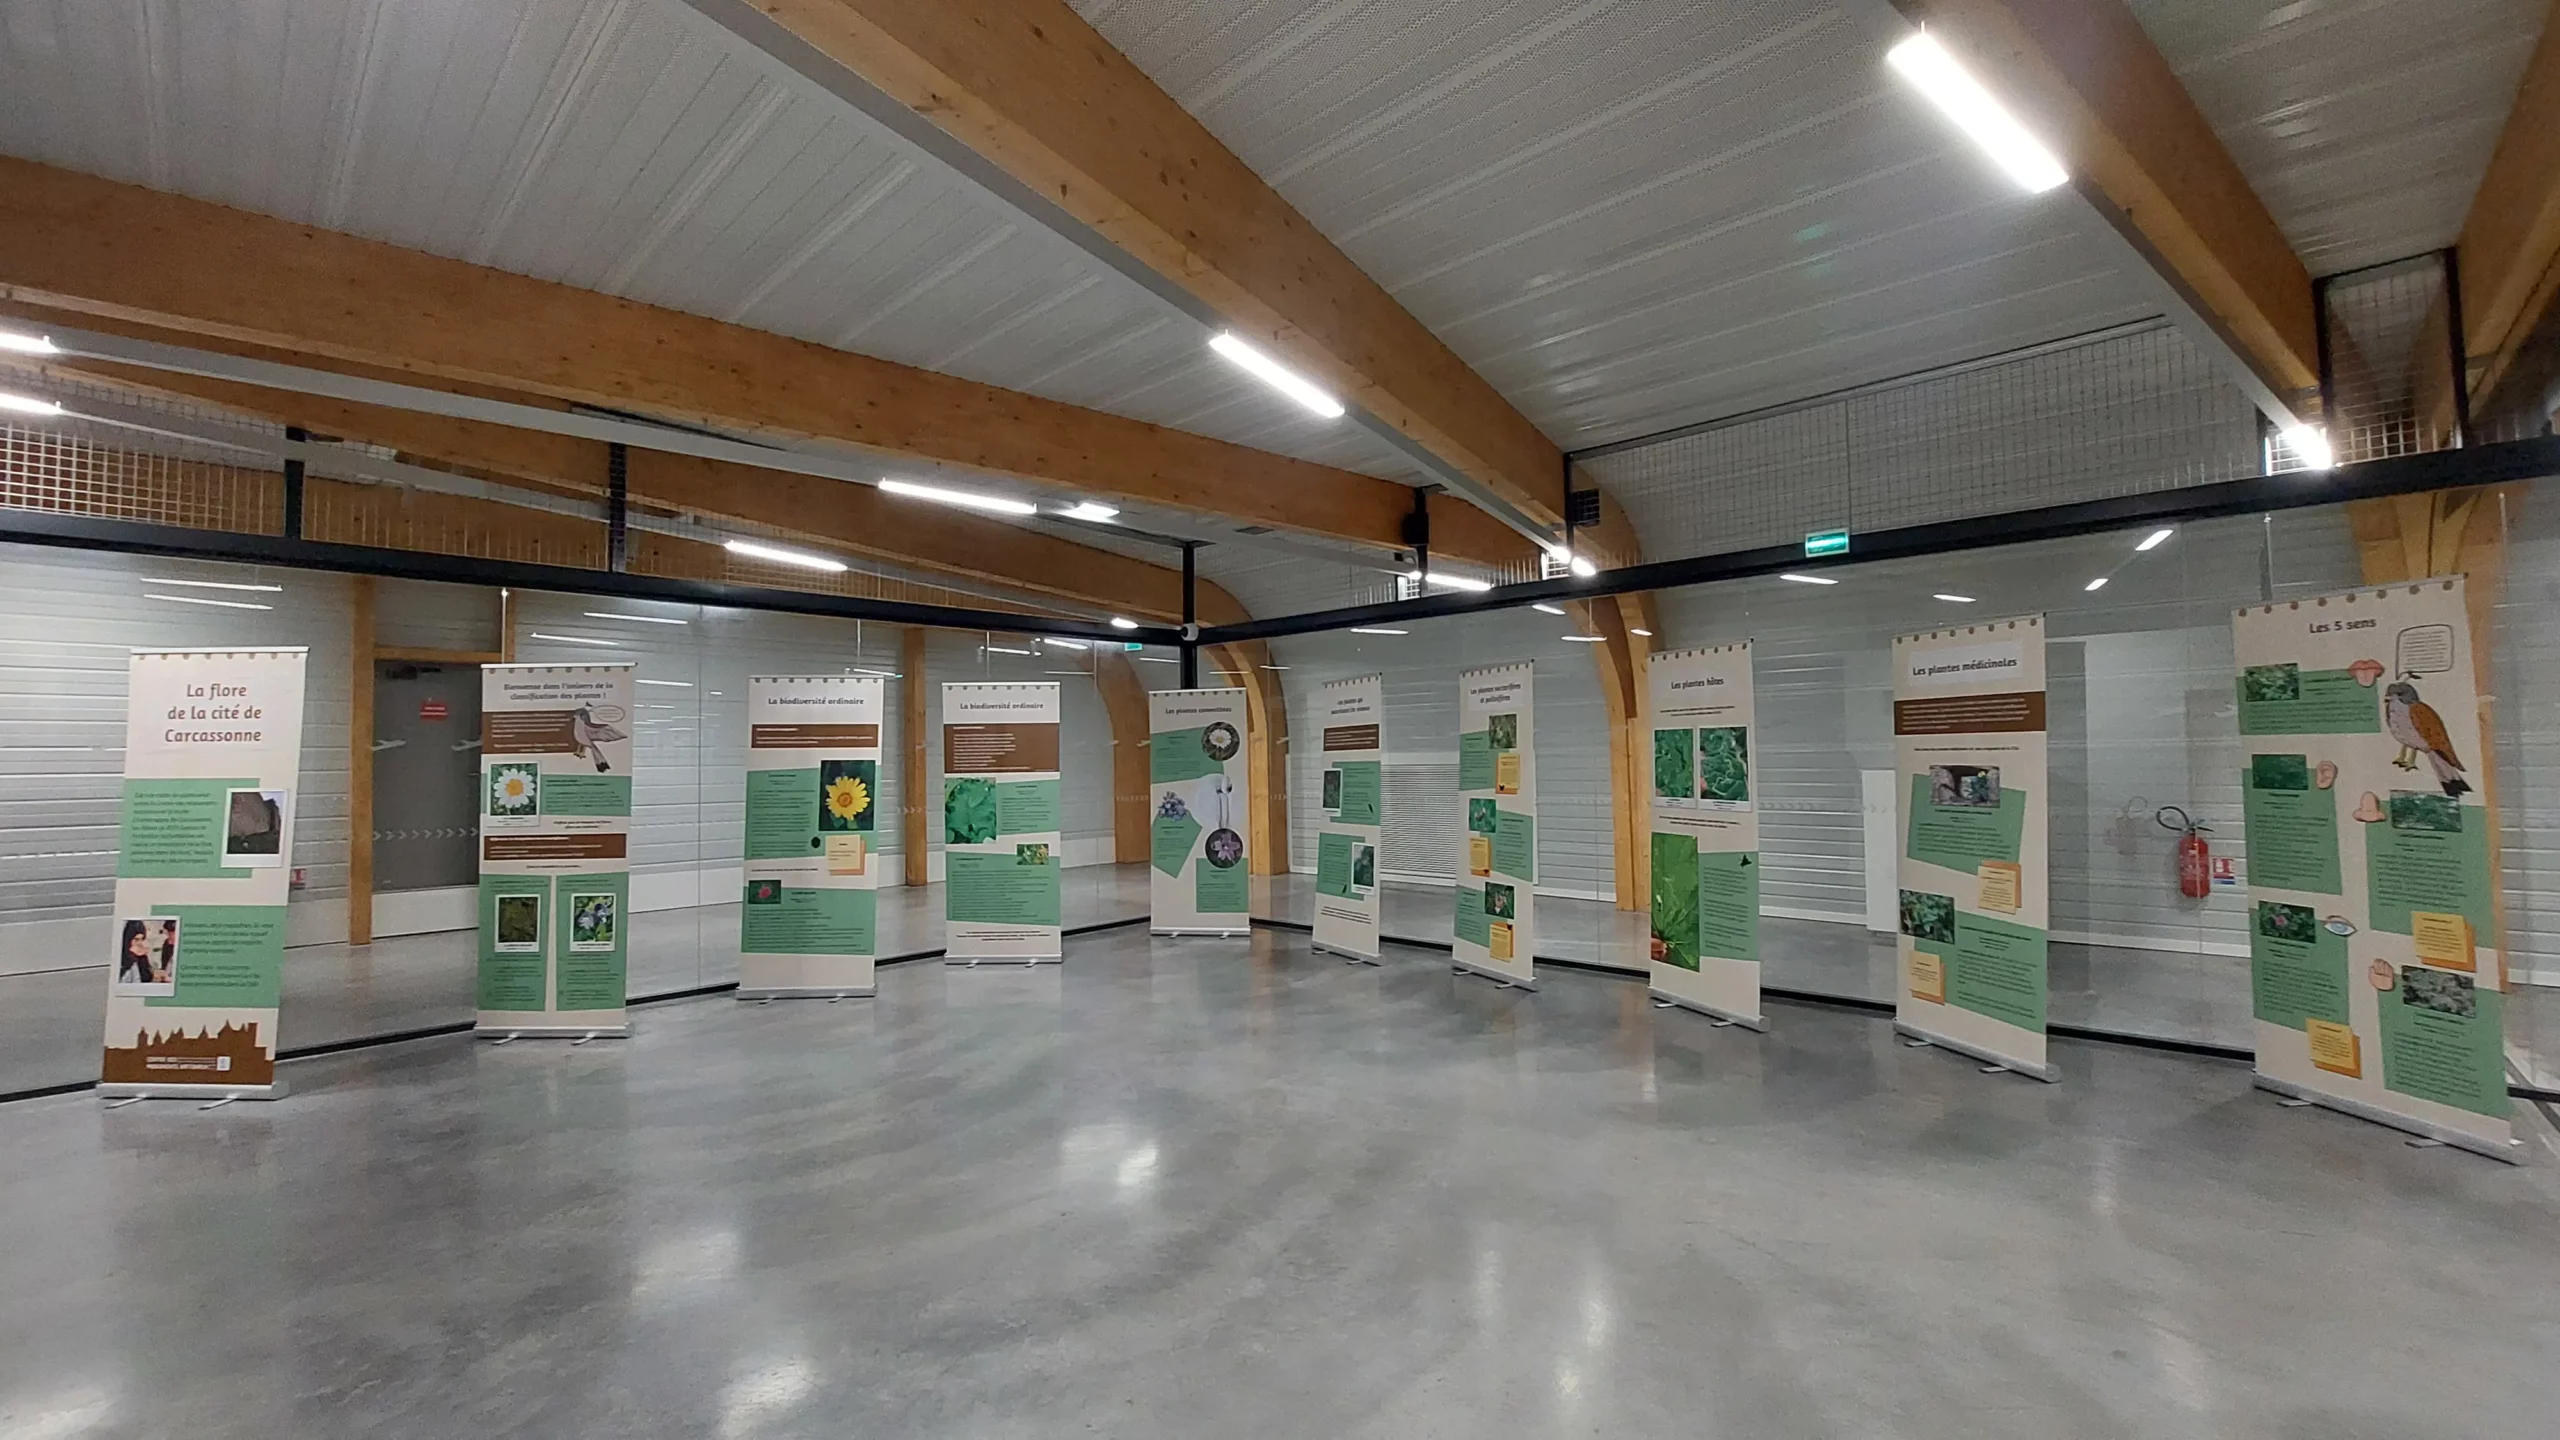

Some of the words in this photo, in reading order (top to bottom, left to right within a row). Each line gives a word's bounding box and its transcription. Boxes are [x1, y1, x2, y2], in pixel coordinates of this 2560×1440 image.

[2309, 623, 2330, 633] Les
[2333, 620, 2342, 631] 5
[2346, 619, 2377, 630] sens
[1912, 667, 1926, 676] Les
[1928, 664, 1960, 676] plantes
[1962, 658, 2017, 671] médicinales
[605, 681, 613, 689] la
[1671, 681, 1681, 689] Les
[1682, 680, 1705, 690] plantes
[1706, 676, 1724, 686] hôtes
[186, 684, 204, 697] La
[208, 683, 247, 700] flore
[574, 692, 601, 700] plantes
[768, 697, 777, 705] La
[779, 696, 827, 705] biodiversité
[828, 697, 864, 705] ordinaire
[970, 701, 1010, 709] biodiversité
[167, 706, 186, 719] de
[191, 706, 206, 719] la
[211, 704, 240, 719] cité
[244, 705, 262, 719] de
[1176, 707, 1197, 715] plantes
[165, 729, 261, 742] Carcassonne
